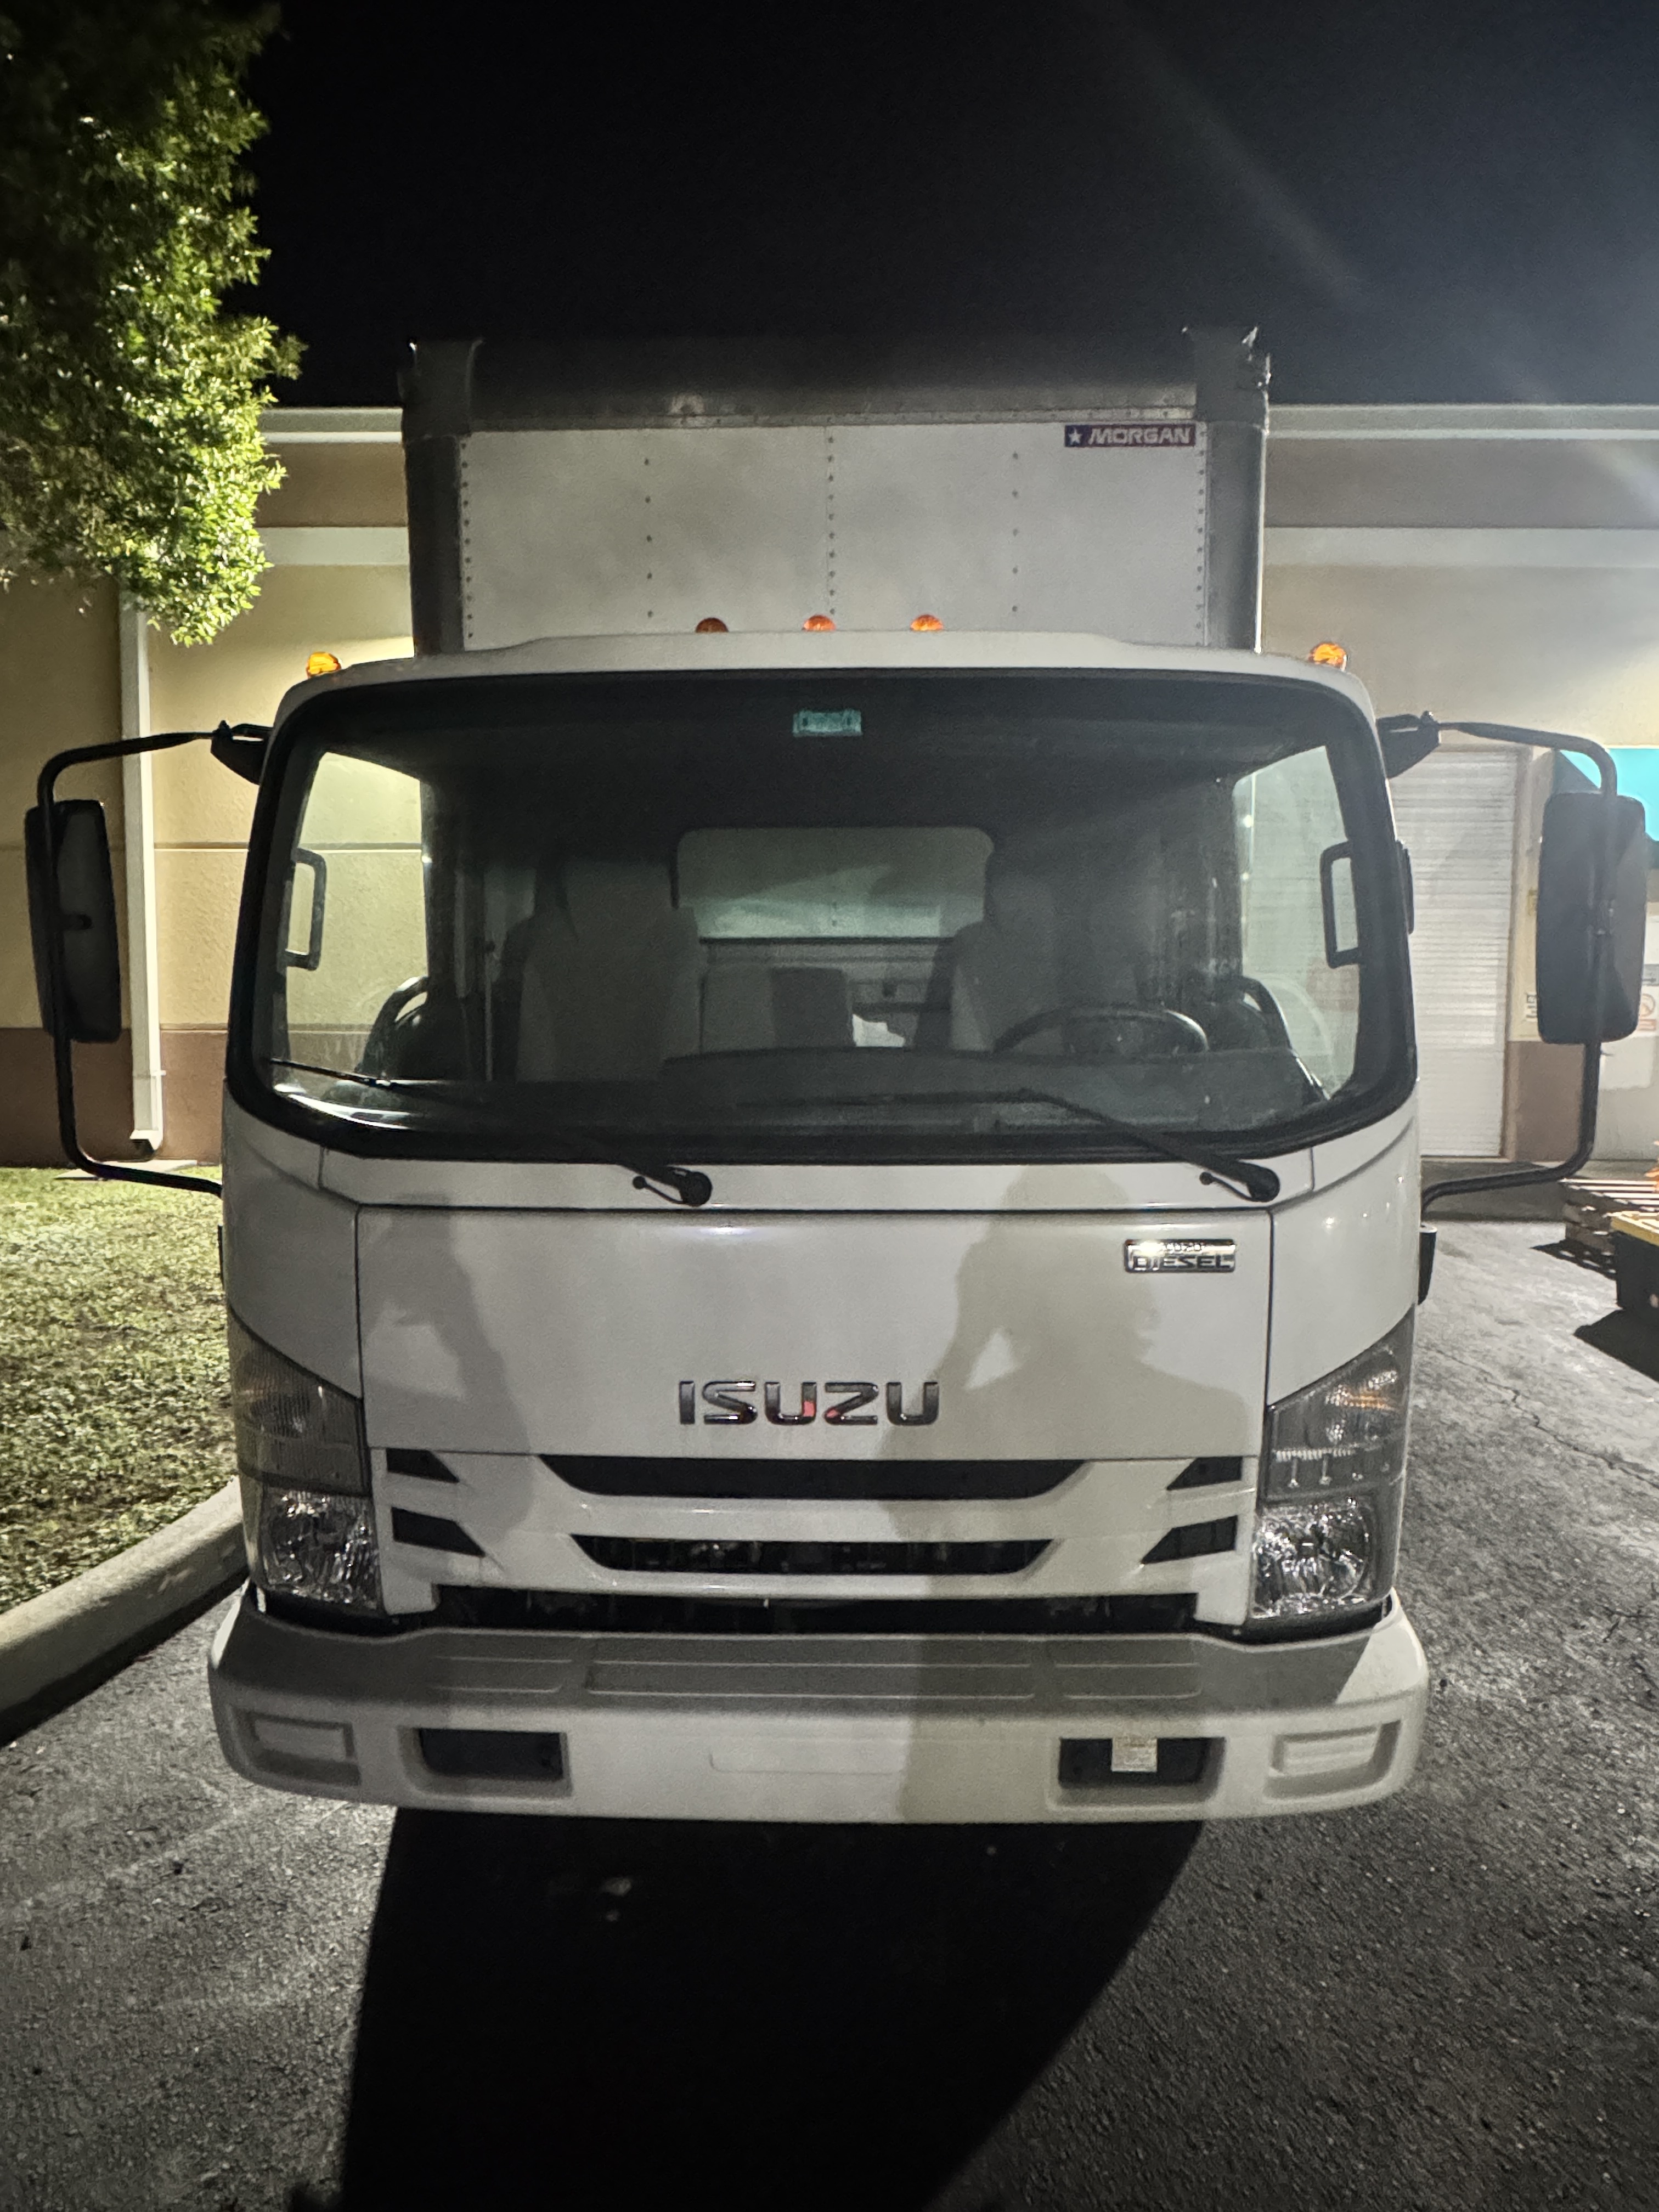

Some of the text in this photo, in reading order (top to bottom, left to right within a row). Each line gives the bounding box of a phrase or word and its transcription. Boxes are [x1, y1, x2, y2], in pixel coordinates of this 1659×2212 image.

[1088, 428, 1191, 444] MORGAN
[1133, 1255, 1231, 1271] DIESEL
[679, 1380, 939, 1425] ISUZU
